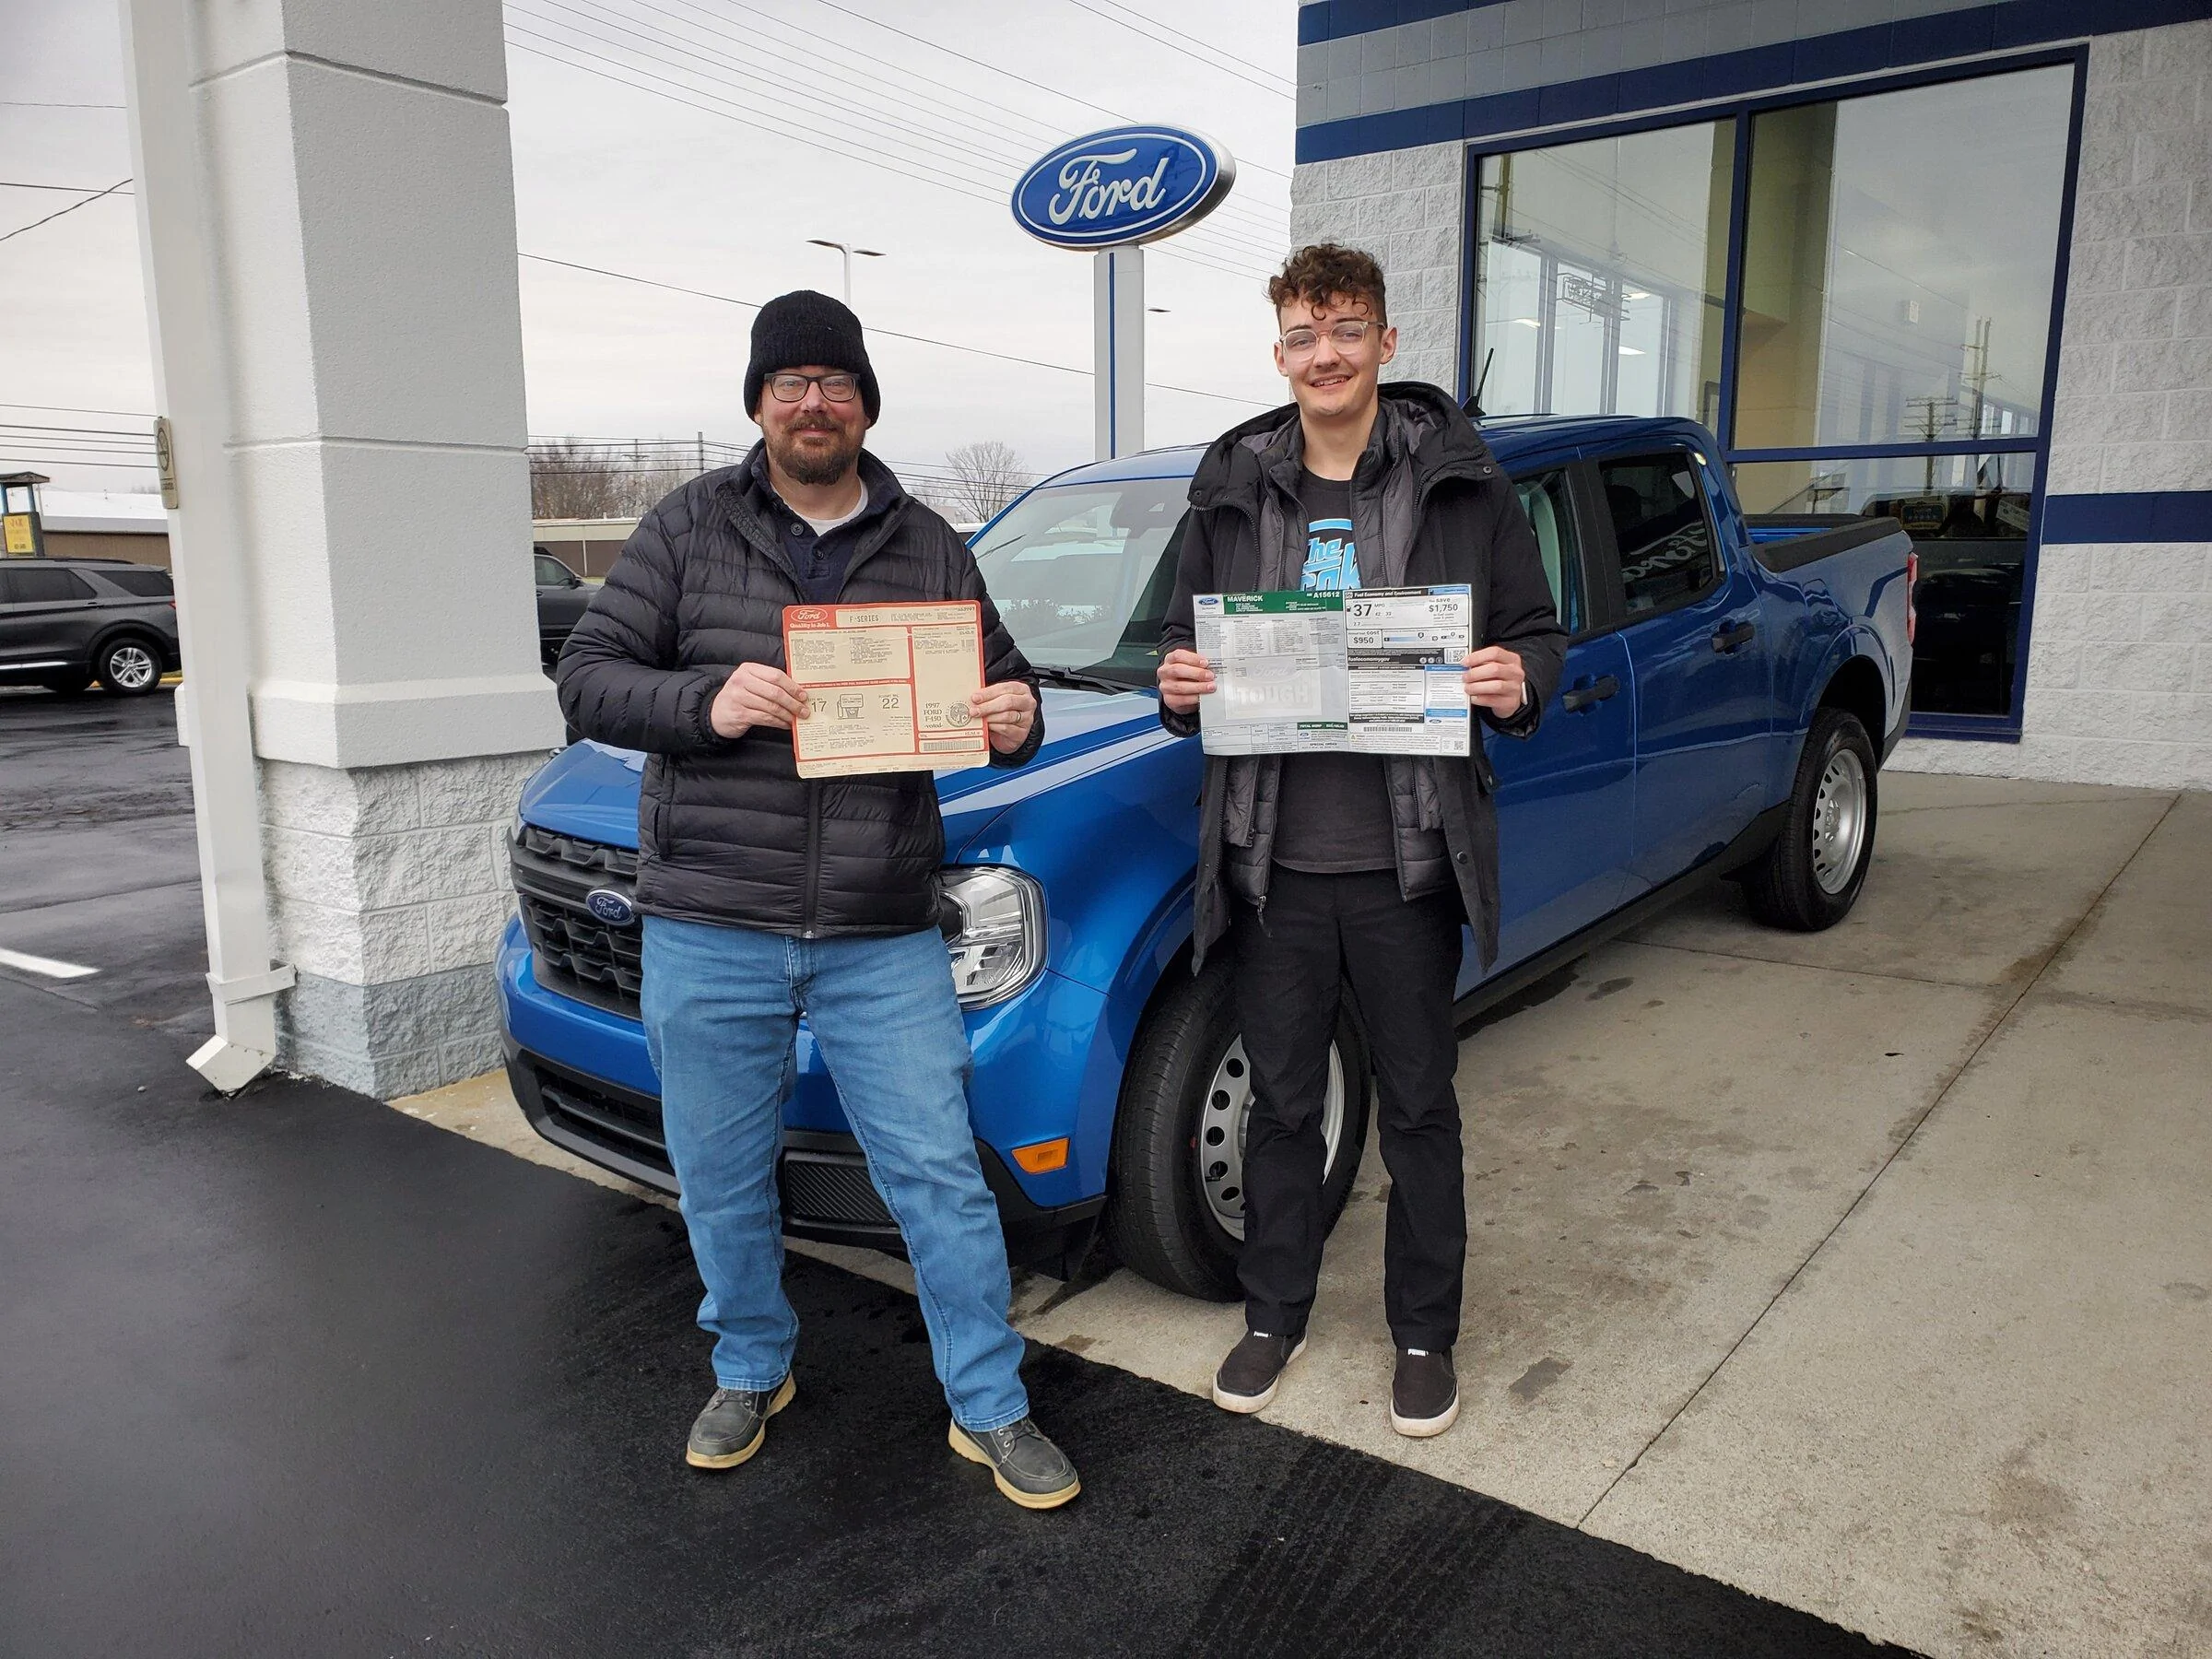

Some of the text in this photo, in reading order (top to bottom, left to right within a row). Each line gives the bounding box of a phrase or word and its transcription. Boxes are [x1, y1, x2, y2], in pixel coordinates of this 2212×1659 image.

[1049, 148, 1169, 225] Ford
[1227, 594, 1264, 603] MAVERICK
[1353, 604, 1372, 617] 37
[1429, 603, 1459, 613] $1,750
[797, 609, 821, 620] Ford
[1254, 663, 1288, 677] Ford
[812, 701, 827, 712] 17
[882, 697, 900, 709] 22
[595, 897, 622, 920] Ford
